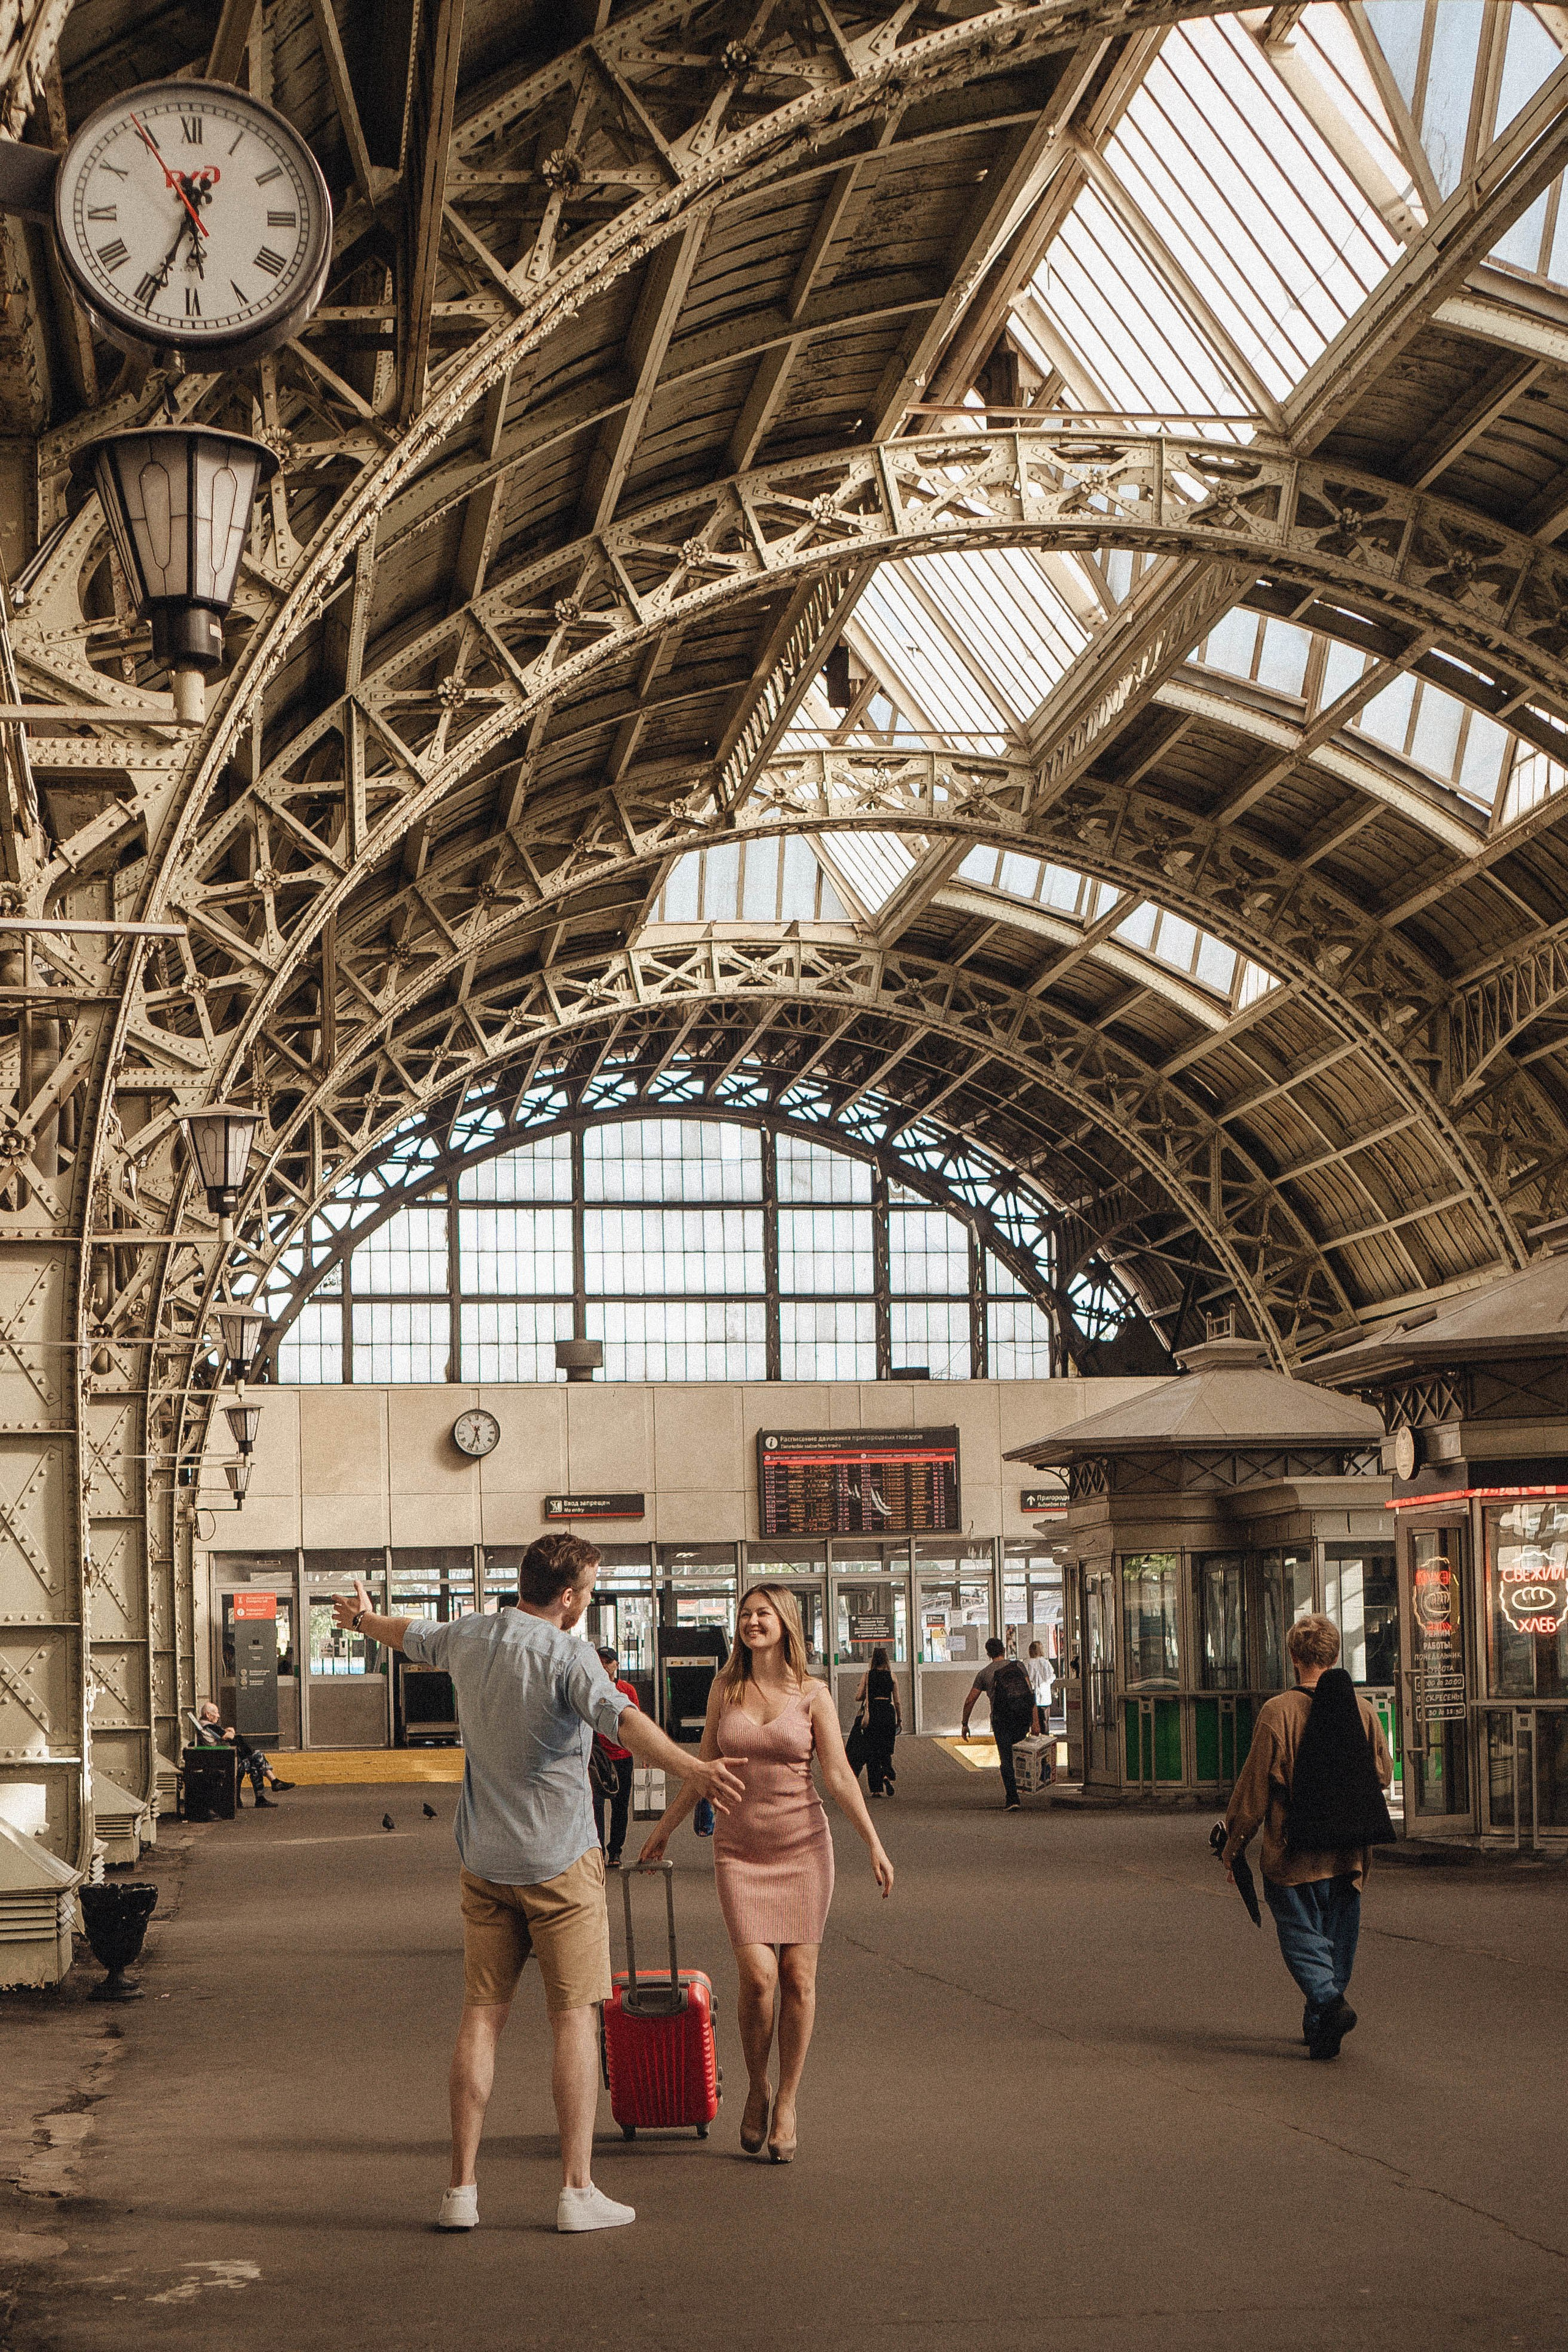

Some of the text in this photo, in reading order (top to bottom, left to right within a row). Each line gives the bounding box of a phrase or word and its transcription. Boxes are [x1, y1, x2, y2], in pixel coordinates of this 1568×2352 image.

[179, 115, 203, 145] XII
[228, 130, 244, 156] I
[99, 160, 129, 181] X
[255, 165, 284, 187] II
[88, 203, 118, 222] IX
[266, 210, 296, 227] III
[185, 287, 203, 317] VI
[230, 279, 249, 307] V
[1502, 1563, 1566, 1583] СВЕЖИЙ
[1517, 1616, 1558, 1634] ХЛЕБ
[1414, 1652, 1463, 1661] ПОНЕДЕЛЬНИК
[1415, 1693, 1464, 1703] ВСКРЕСЕНЬЕ
